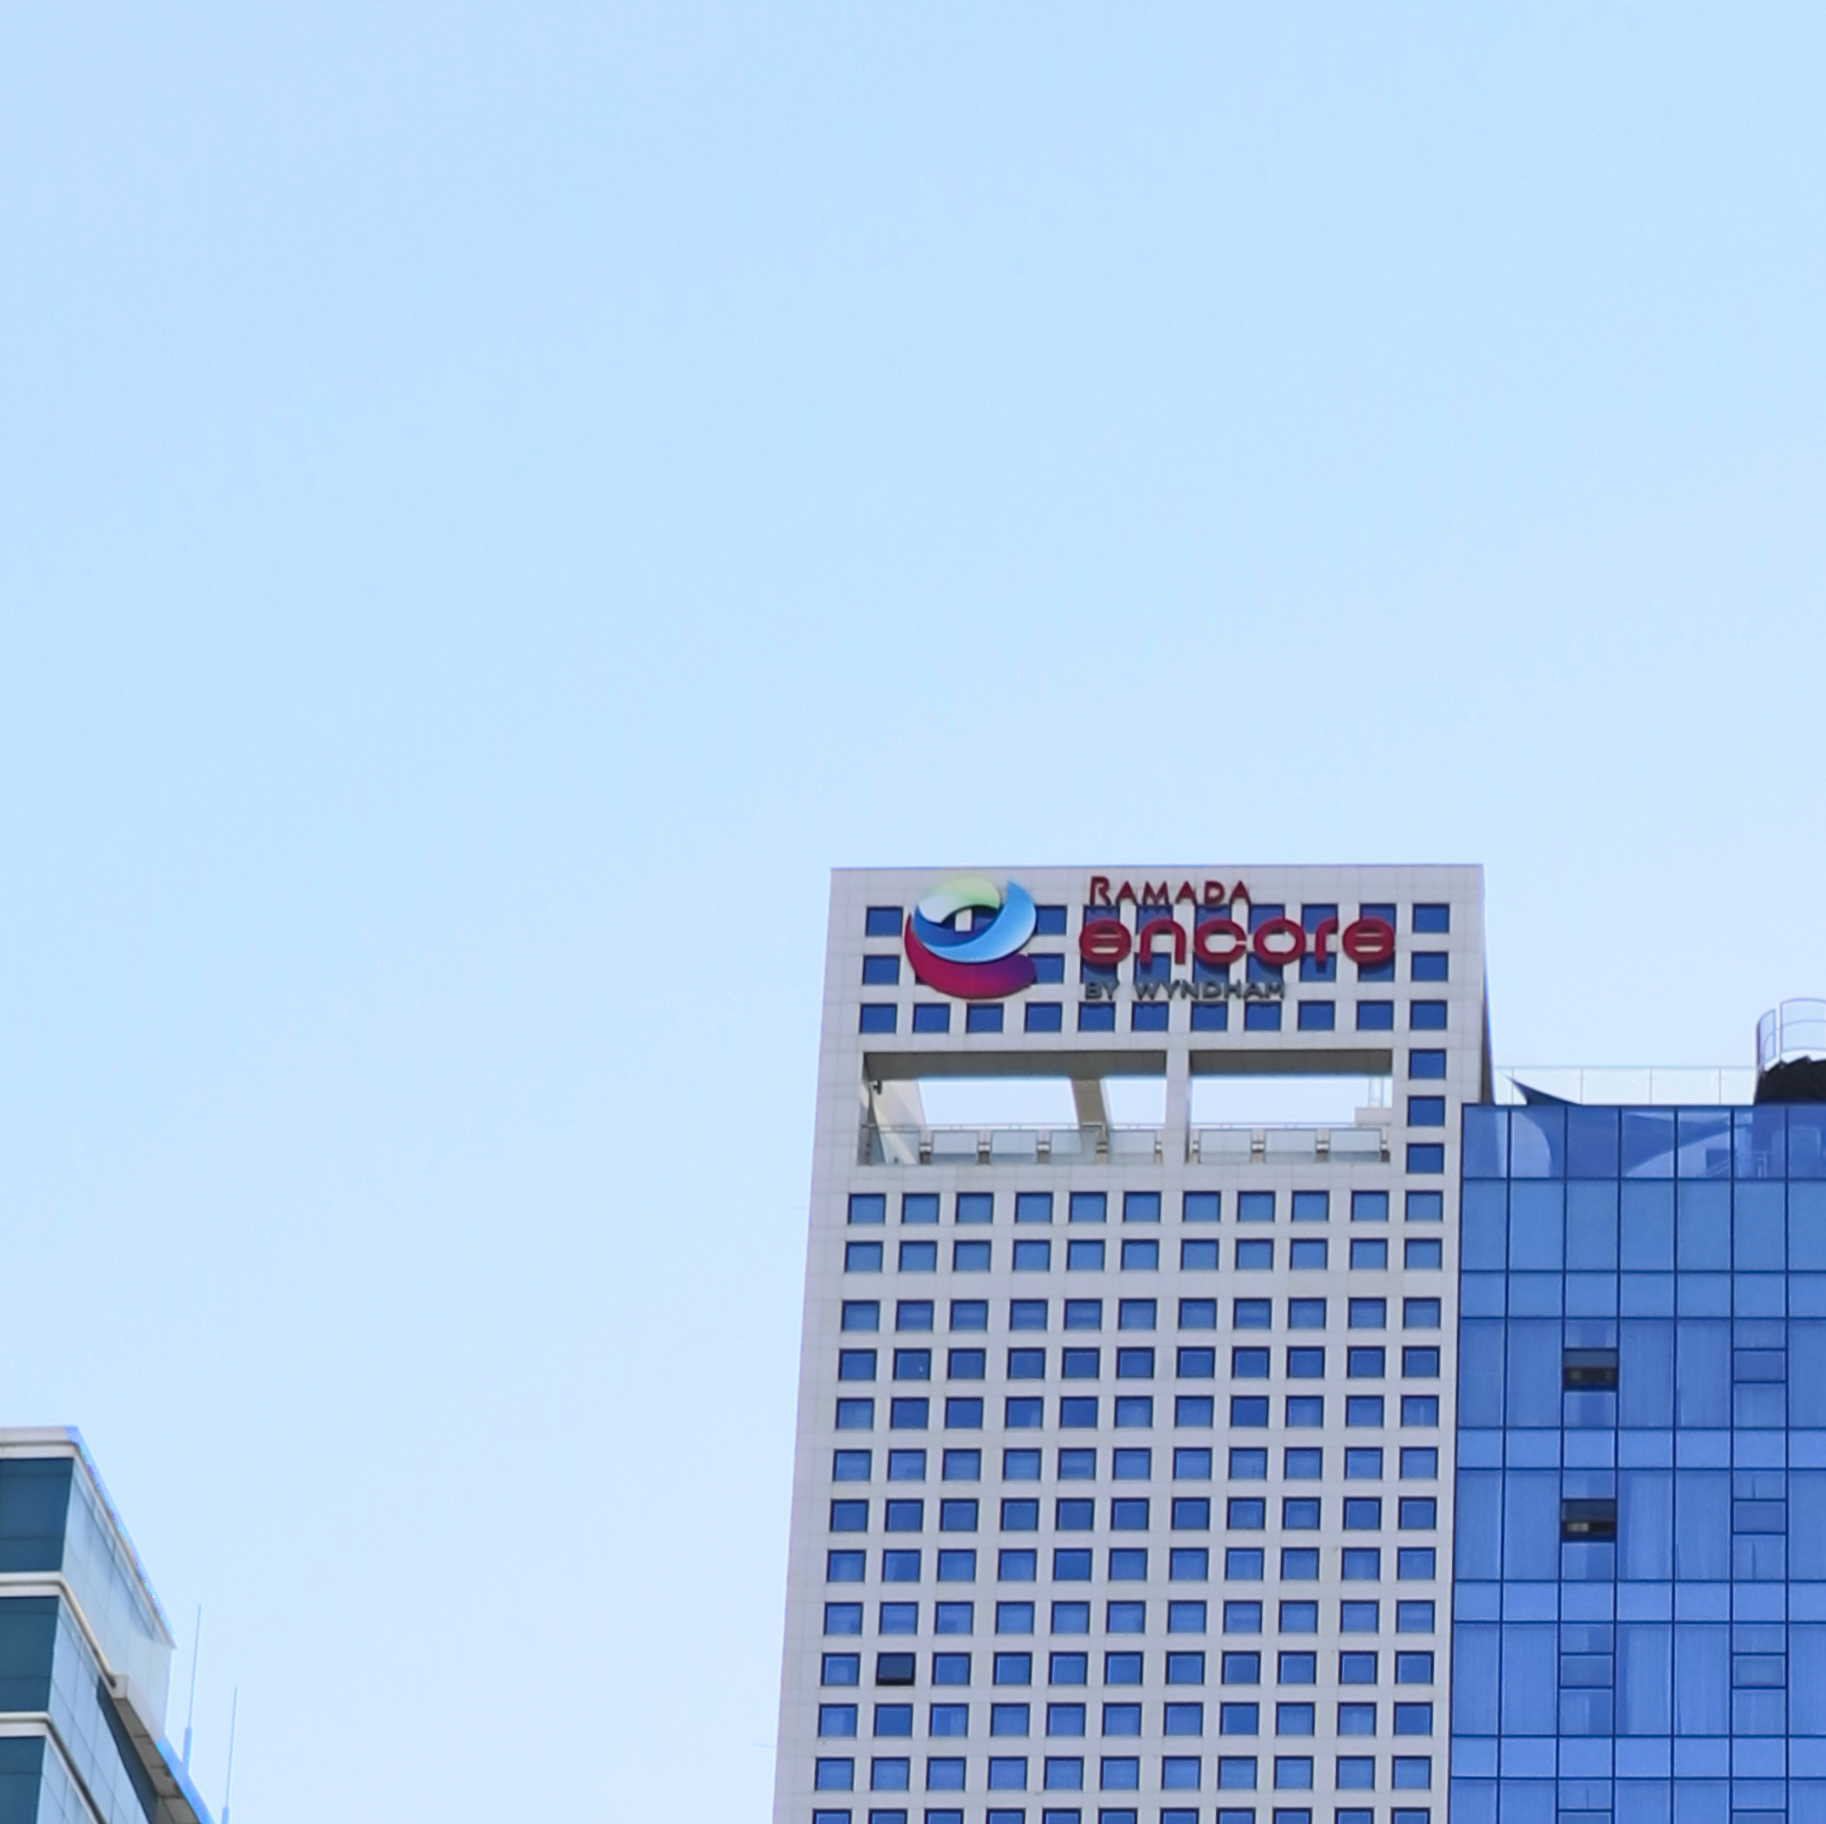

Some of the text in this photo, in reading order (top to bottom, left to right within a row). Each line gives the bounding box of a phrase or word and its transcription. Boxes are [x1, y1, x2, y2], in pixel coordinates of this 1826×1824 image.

[1089, 876, 1252, 906] RAMADA
[1079, 917, 1395, 967] encore
[1085, 979, 1286, 1001] BY WYNDHAM
